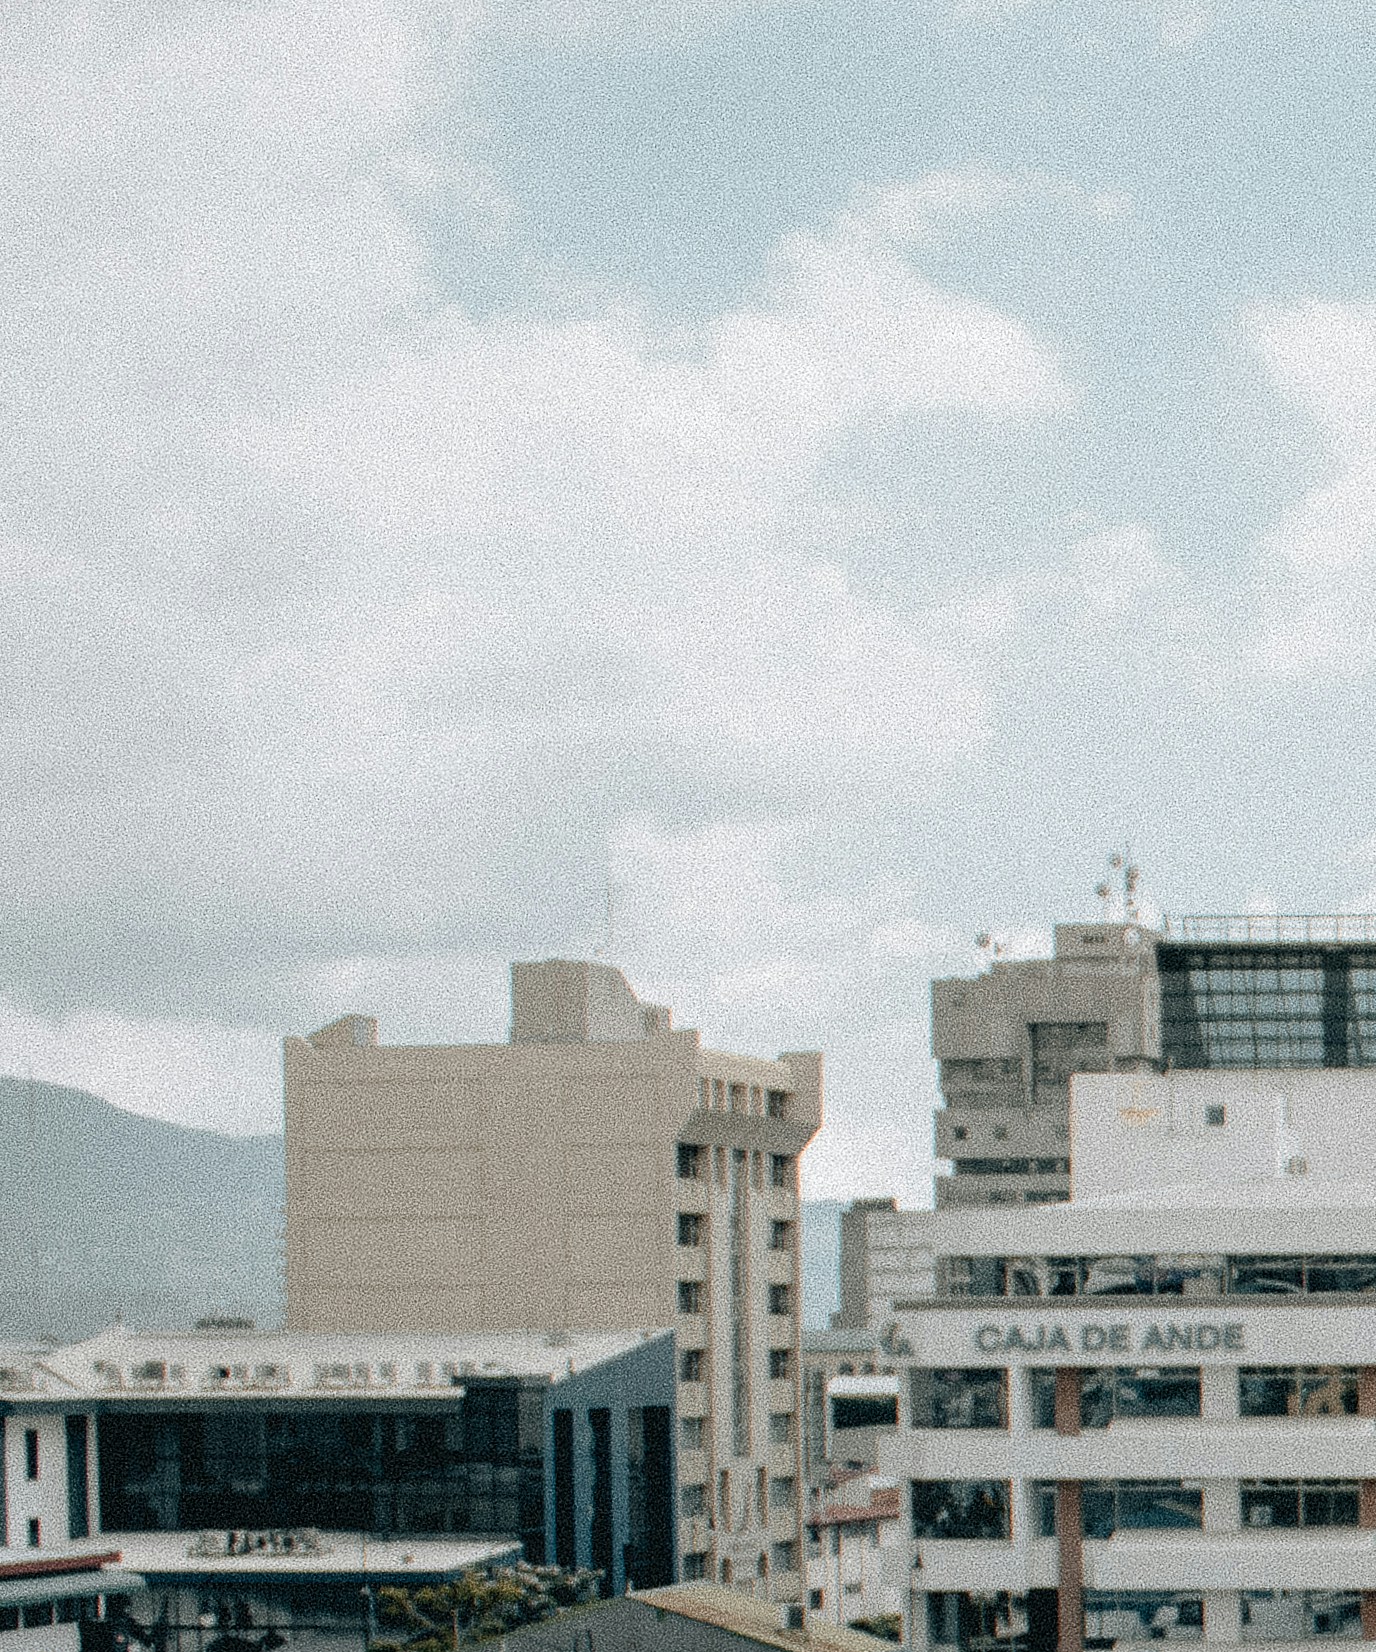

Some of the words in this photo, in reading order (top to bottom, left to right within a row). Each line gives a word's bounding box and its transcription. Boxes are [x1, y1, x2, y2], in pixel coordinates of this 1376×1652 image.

[975, 1324, 1070, 1352] CAJA
[1080, 1324, 1130, 1352] DE
[1141, 1323, 1245, 1351] ANDE
